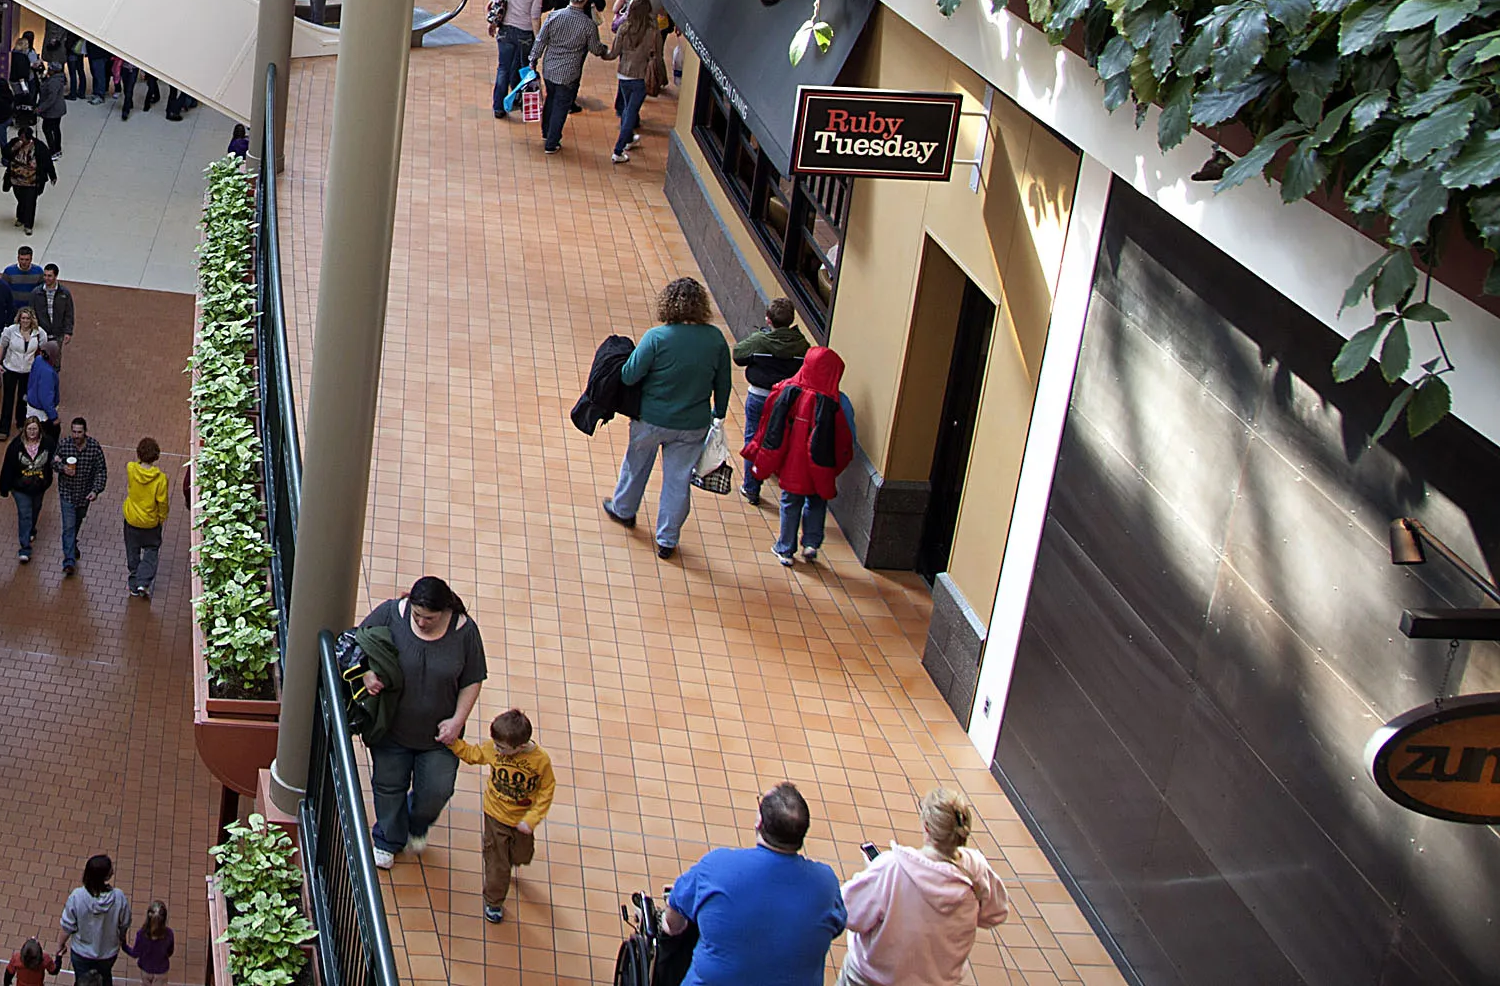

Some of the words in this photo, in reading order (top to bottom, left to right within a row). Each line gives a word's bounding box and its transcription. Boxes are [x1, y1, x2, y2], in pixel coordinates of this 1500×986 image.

[710, 60, 732, 98] AMERICAN
[731, 88, 748, 120] DINING
[825, 109, 904, 140] Ruby
[814, 131, 939, 164] Tuesday
